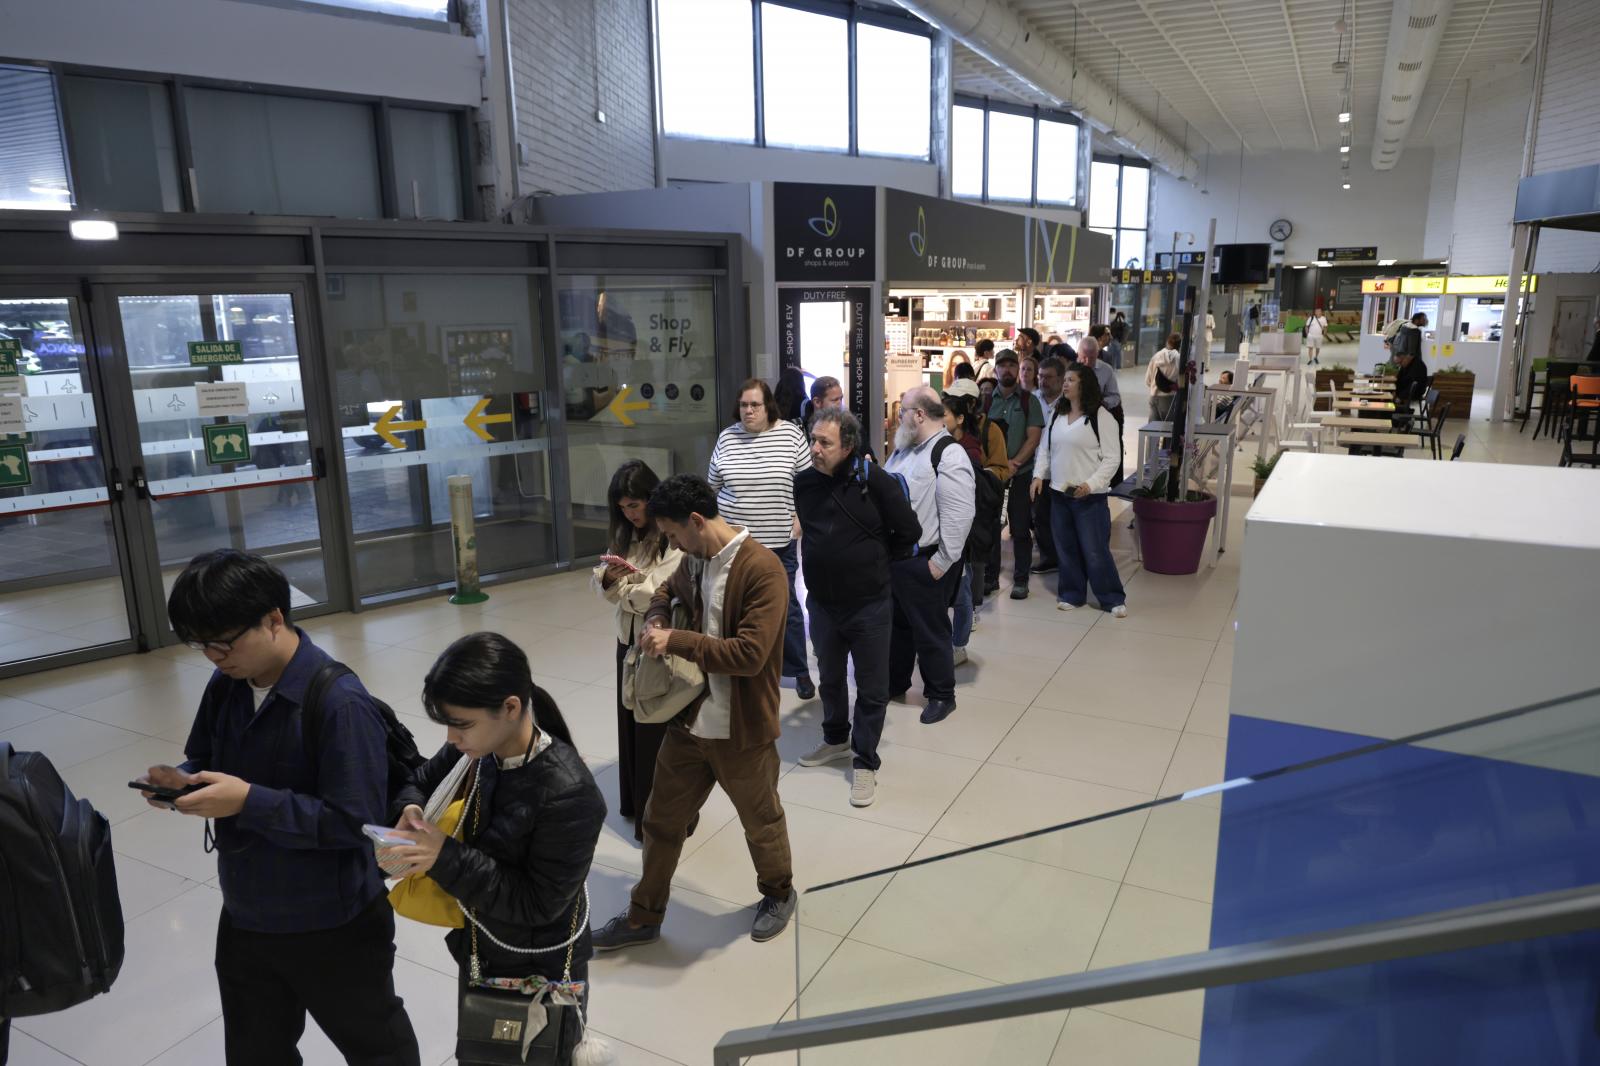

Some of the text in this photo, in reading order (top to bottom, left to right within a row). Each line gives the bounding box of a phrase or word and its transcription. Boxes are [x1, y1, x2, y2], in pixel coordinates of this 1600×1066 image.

[786, 247, 866, 258] DF GROUP
[927, 255, 938, 268] DF
[941, 256, 967, 270] GROUP
[803, 291, 847, 300] DUTY FREE
[649, 313, 692, 334] Shop
[195, 344, 235, 354] SALIDA DE
[649, 336, 693, 358] & Fly
[786, 331, 794, 355] SHOP
[191, 353, 242, 364] EMERGENCIA
